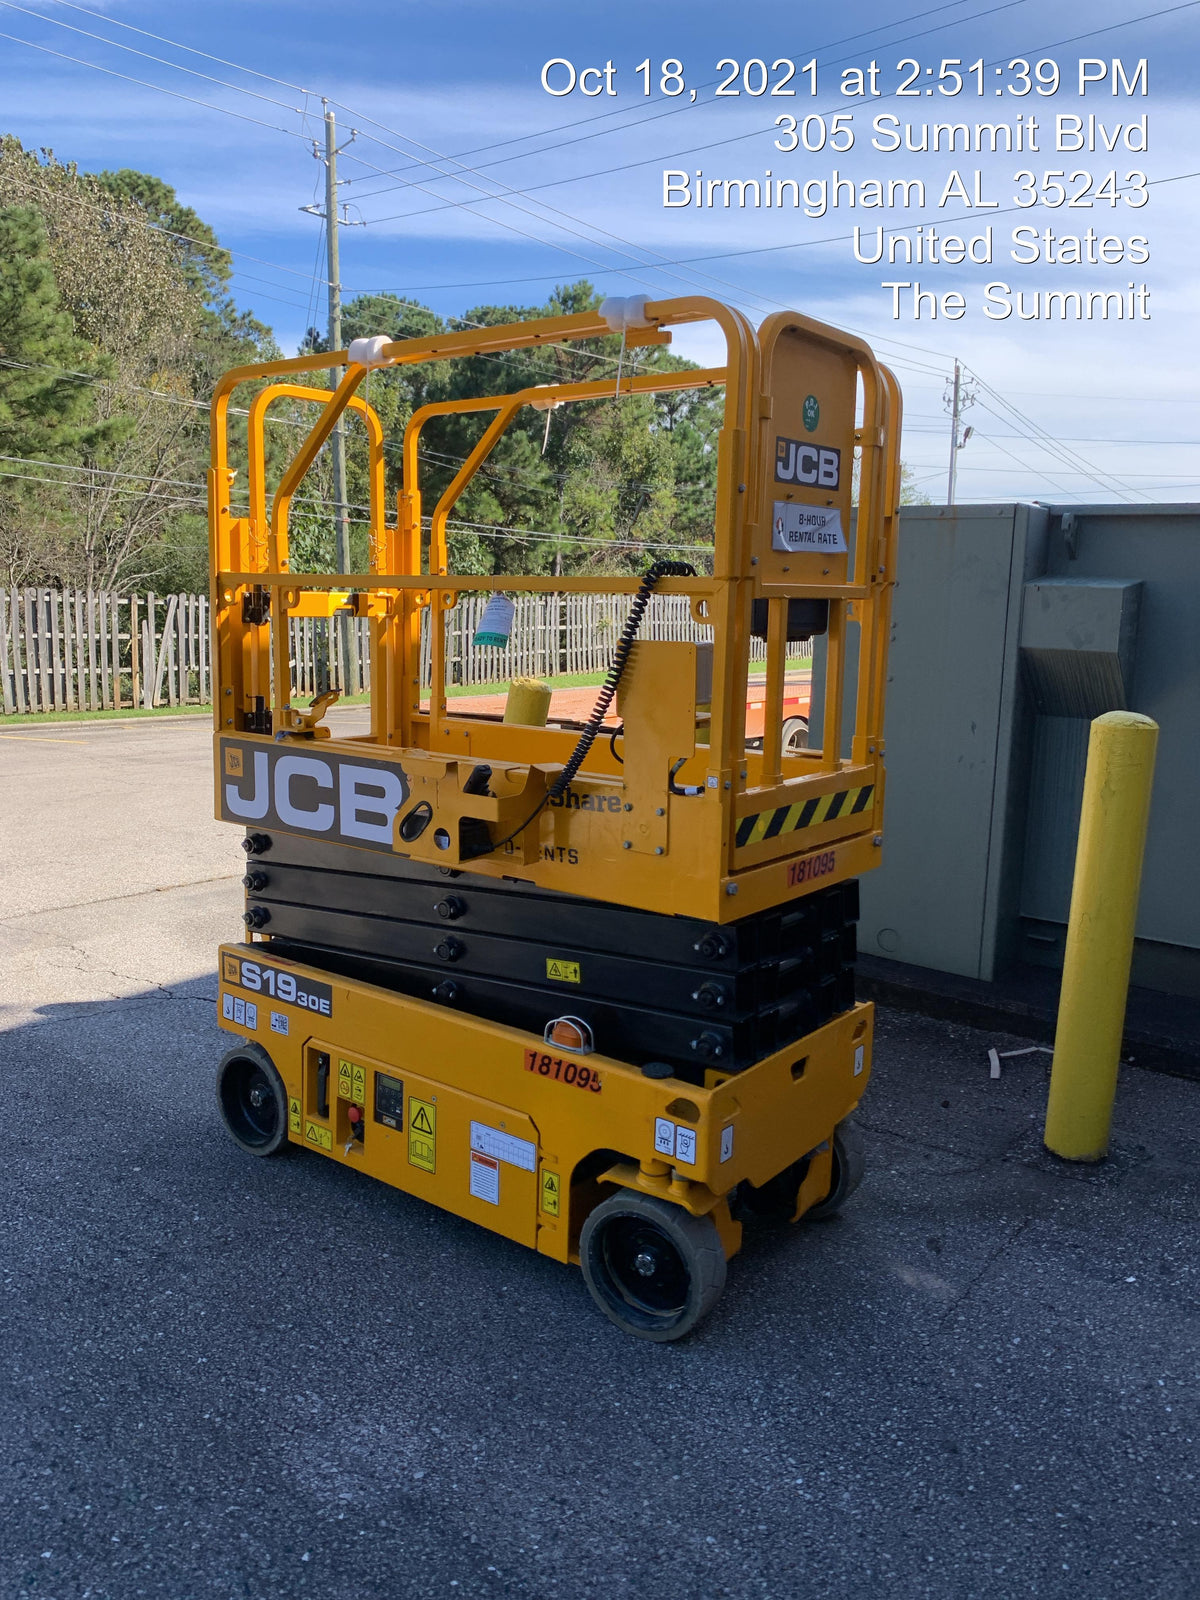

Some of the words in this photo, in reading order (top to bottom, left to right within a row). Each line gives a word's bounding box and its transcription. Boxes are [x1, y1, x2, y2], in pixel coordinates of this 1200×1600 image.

[777, 444, 839, 486] JCB
[788, 531, 816, 544] RENTAL
[817, 533, 838, 545] RATE
[226, 751, 403, 844] JCB
[790, 851, 835, 885] 181095
[528, 1051, 602, 1093] 181095
